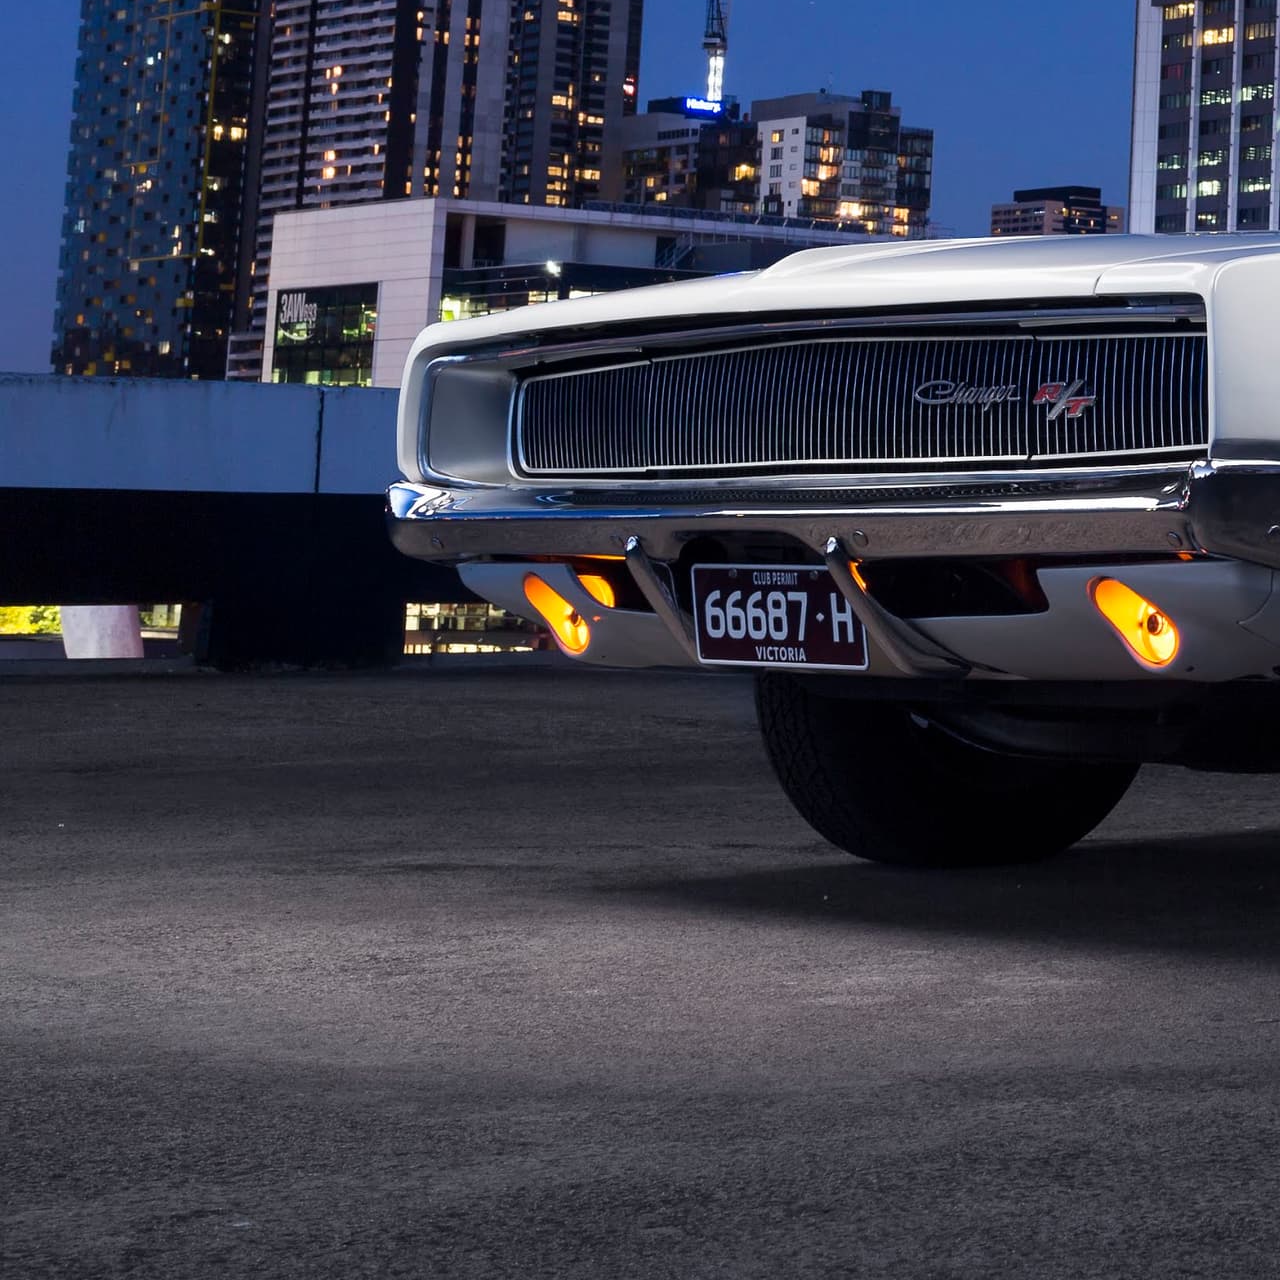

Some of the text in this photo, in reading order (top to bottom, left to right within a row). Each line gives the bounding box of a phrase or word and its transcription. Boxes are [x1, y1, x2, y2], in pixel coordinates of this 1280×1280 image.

[914, 378, 1097, 421] Charger R/T
[752, 571, 799, 586] CLUB PERMIT
[754, 645, 807, 662] VICTORIA
